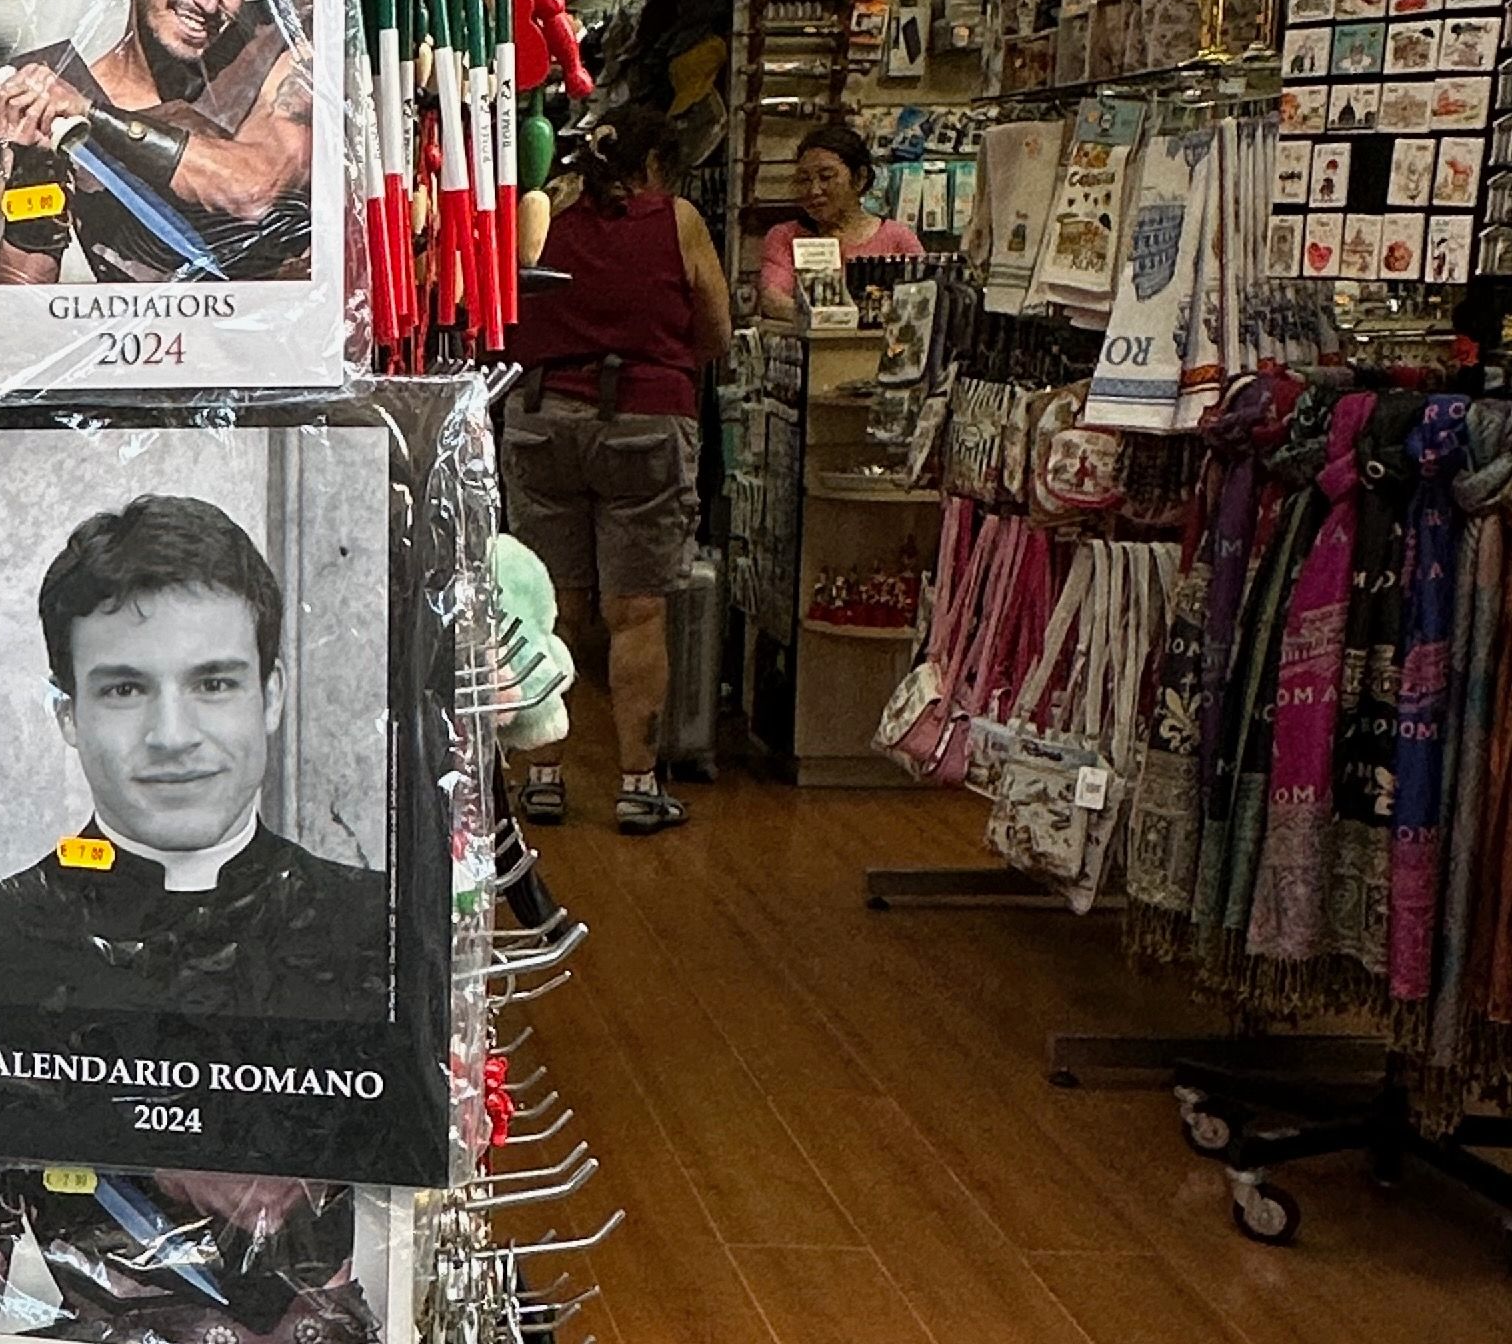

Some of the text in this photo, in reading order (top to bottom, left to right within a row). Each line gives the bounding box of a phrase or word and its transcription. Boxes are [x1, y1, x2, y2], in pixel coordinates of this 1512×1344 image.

[48, 294, 236, 319] GLADIATORS
[97, 331, 187, 366] 2024
[208, 1062, 385, 1100] ROMANO
[133, 1104, 203, 1134] 2024
